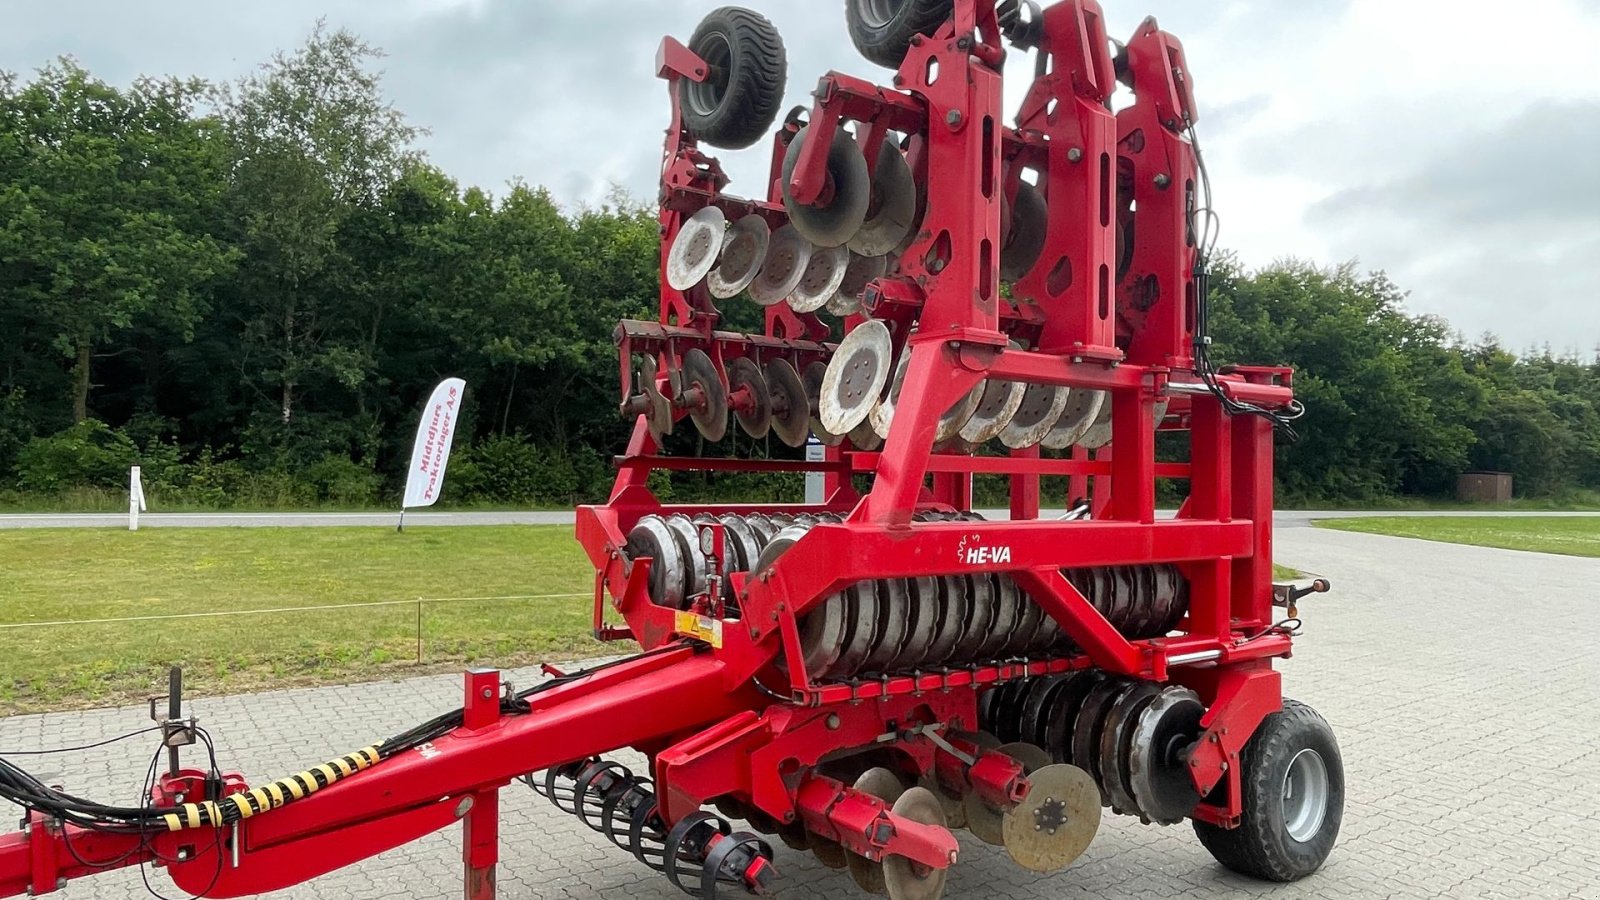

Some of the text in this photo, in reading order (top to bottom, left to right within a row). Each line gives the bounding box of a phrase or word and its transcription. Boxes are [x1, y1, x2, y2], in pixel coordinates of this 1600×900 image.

[420, 404, 442, 473] Midtdjurs
[424, 386, 457, 500] Traktorlager A/S
[966, 546, 1011, 564] HE-VA
